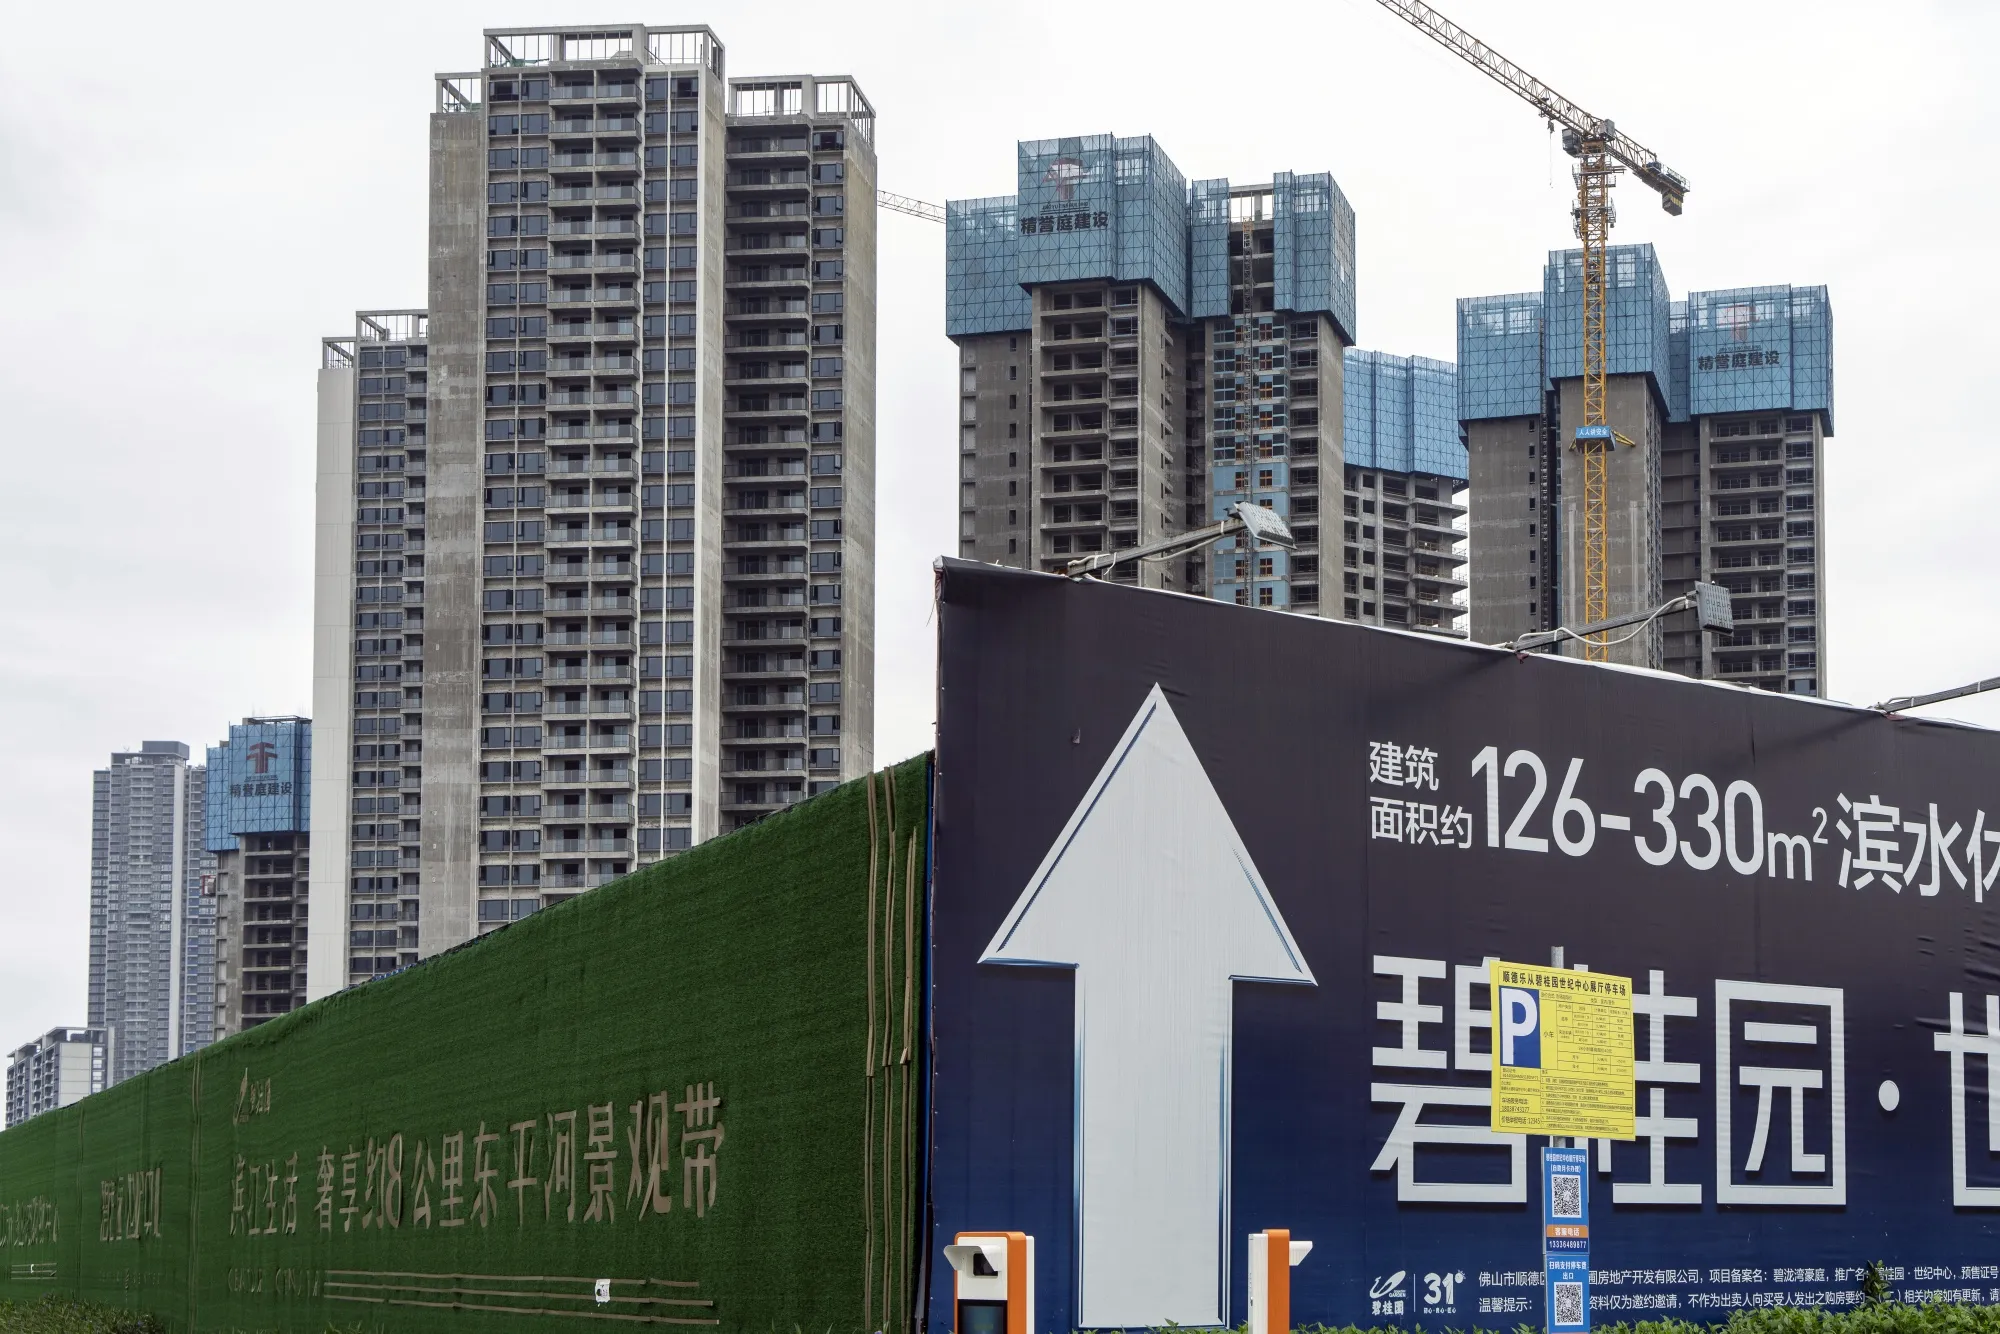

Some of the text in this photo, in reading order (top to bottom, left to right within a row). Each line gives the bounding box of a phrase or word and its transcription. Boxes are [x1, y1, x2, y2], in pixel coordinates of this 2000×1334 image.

[1020, 211, 1108, 235] 精誉庭建设
[1697, 350, 1780, 371] 精誉庭建设
[1368, 741, 1440, 791] 建筑
[1370, 797, 1473, 850] 面积约
[1502, 971, 1626, 996] 顺德乐从碧桂园世纪中心展厅停车场
[1501, 988, 1537, 1065] P
[229, 1152, 298, 1236] 滨江生活
[314, 1081, 726, 1234] 奢享约8公里东平河景观带
[1563, 1272, 1574, 1280] 出口
